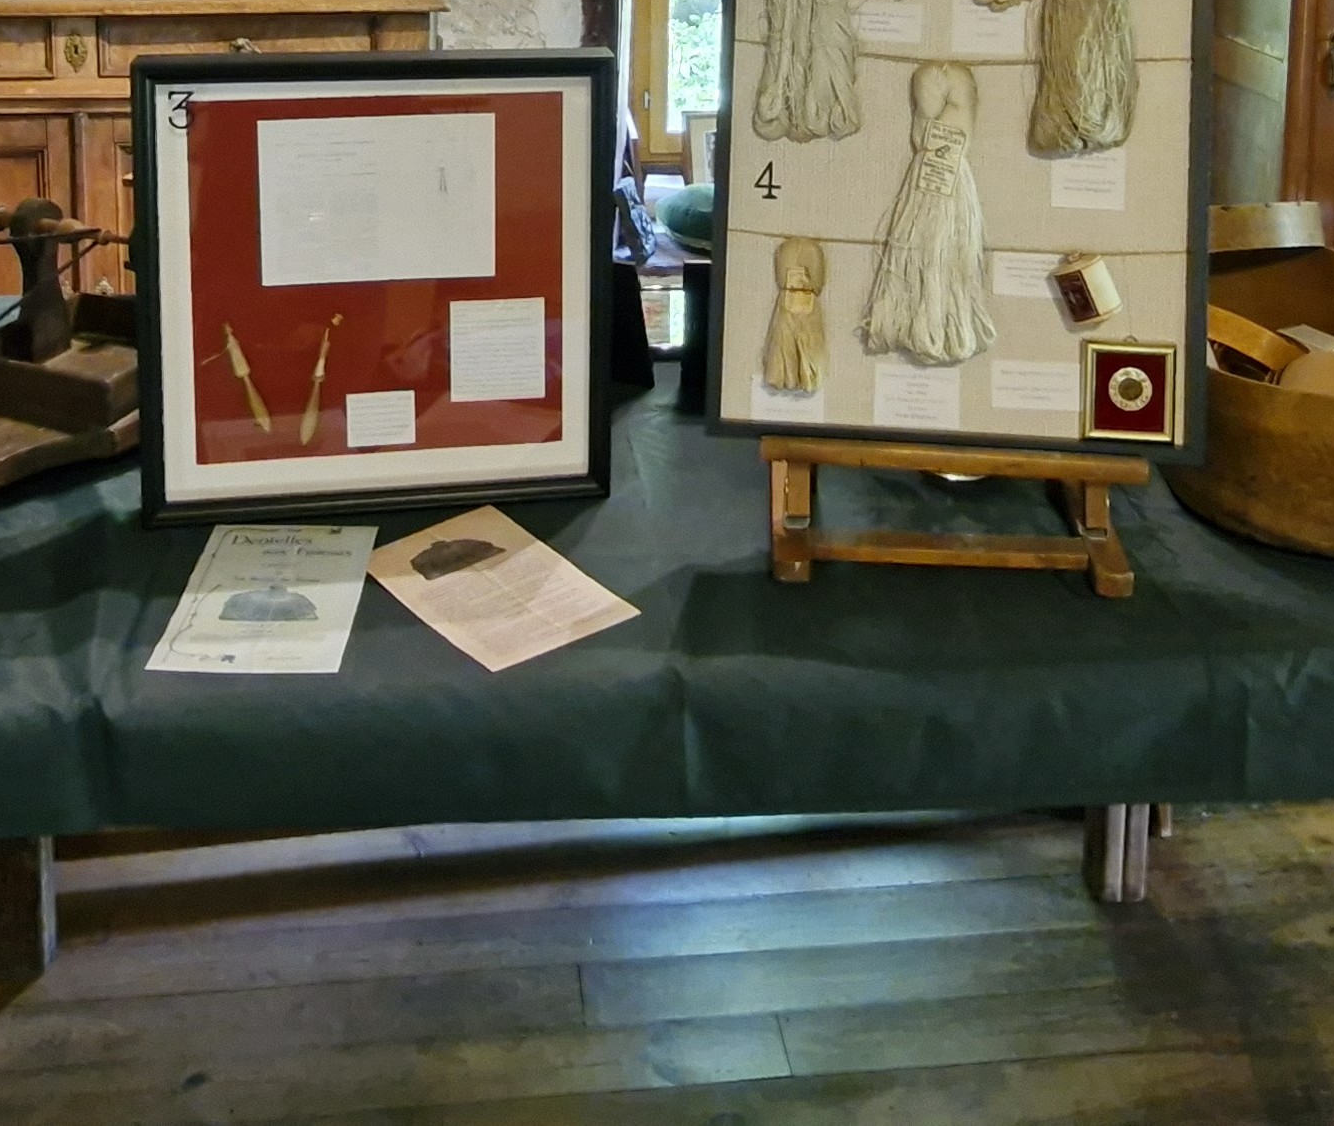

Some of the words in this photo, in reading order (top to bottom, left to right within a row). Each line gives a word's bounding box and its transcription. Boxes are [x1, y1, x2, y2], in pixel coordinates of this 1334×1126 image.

[168, 91, 194, 129] 3
[754, 160, 782, 200] 4
[231, 534, 313, 545] Dentelles
